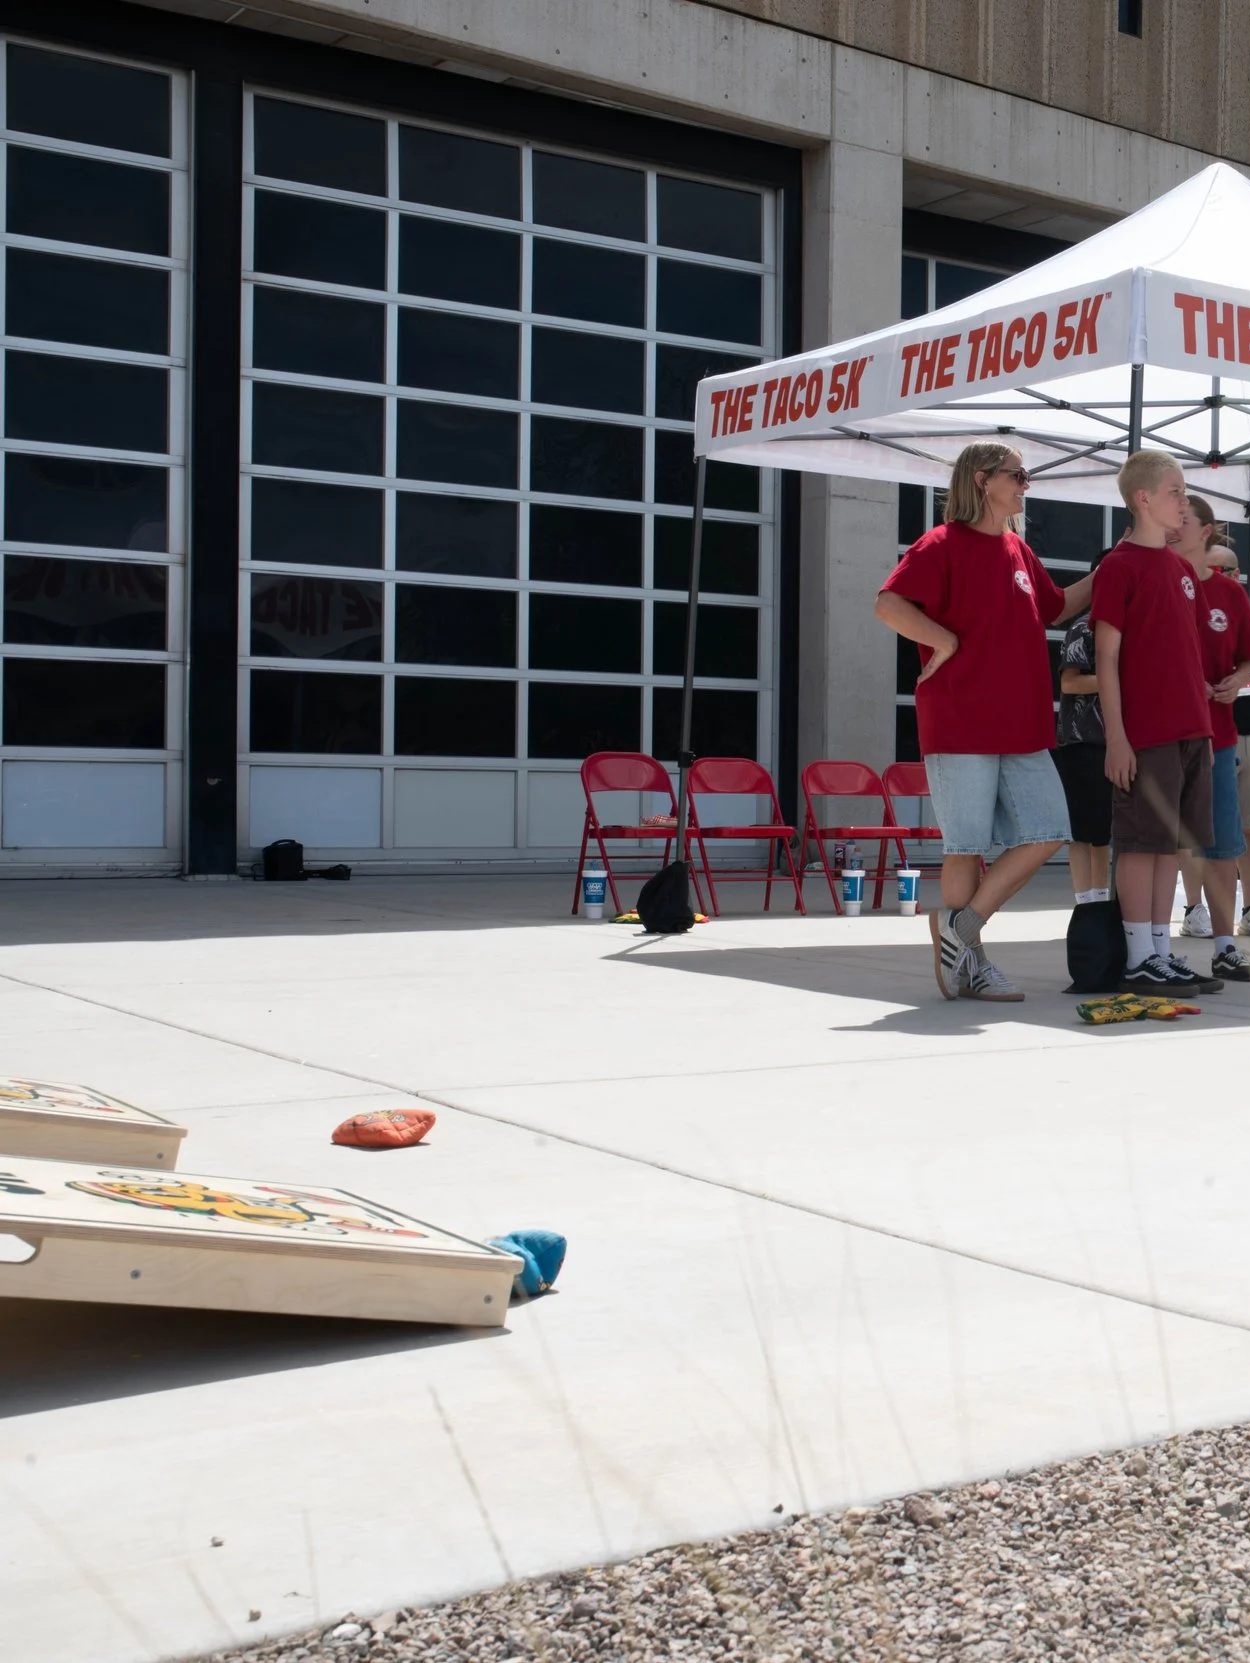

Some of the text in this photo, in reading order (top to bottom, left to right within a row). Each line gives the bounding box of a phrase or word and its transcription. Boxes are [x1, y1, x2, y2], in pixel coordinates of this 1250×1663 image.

[900, 333, 962, 398] THE
[966, 312, 1047, 383] TACO
[711, 384, 757, 438] THE
[762, 369, 823, 428] TACO
